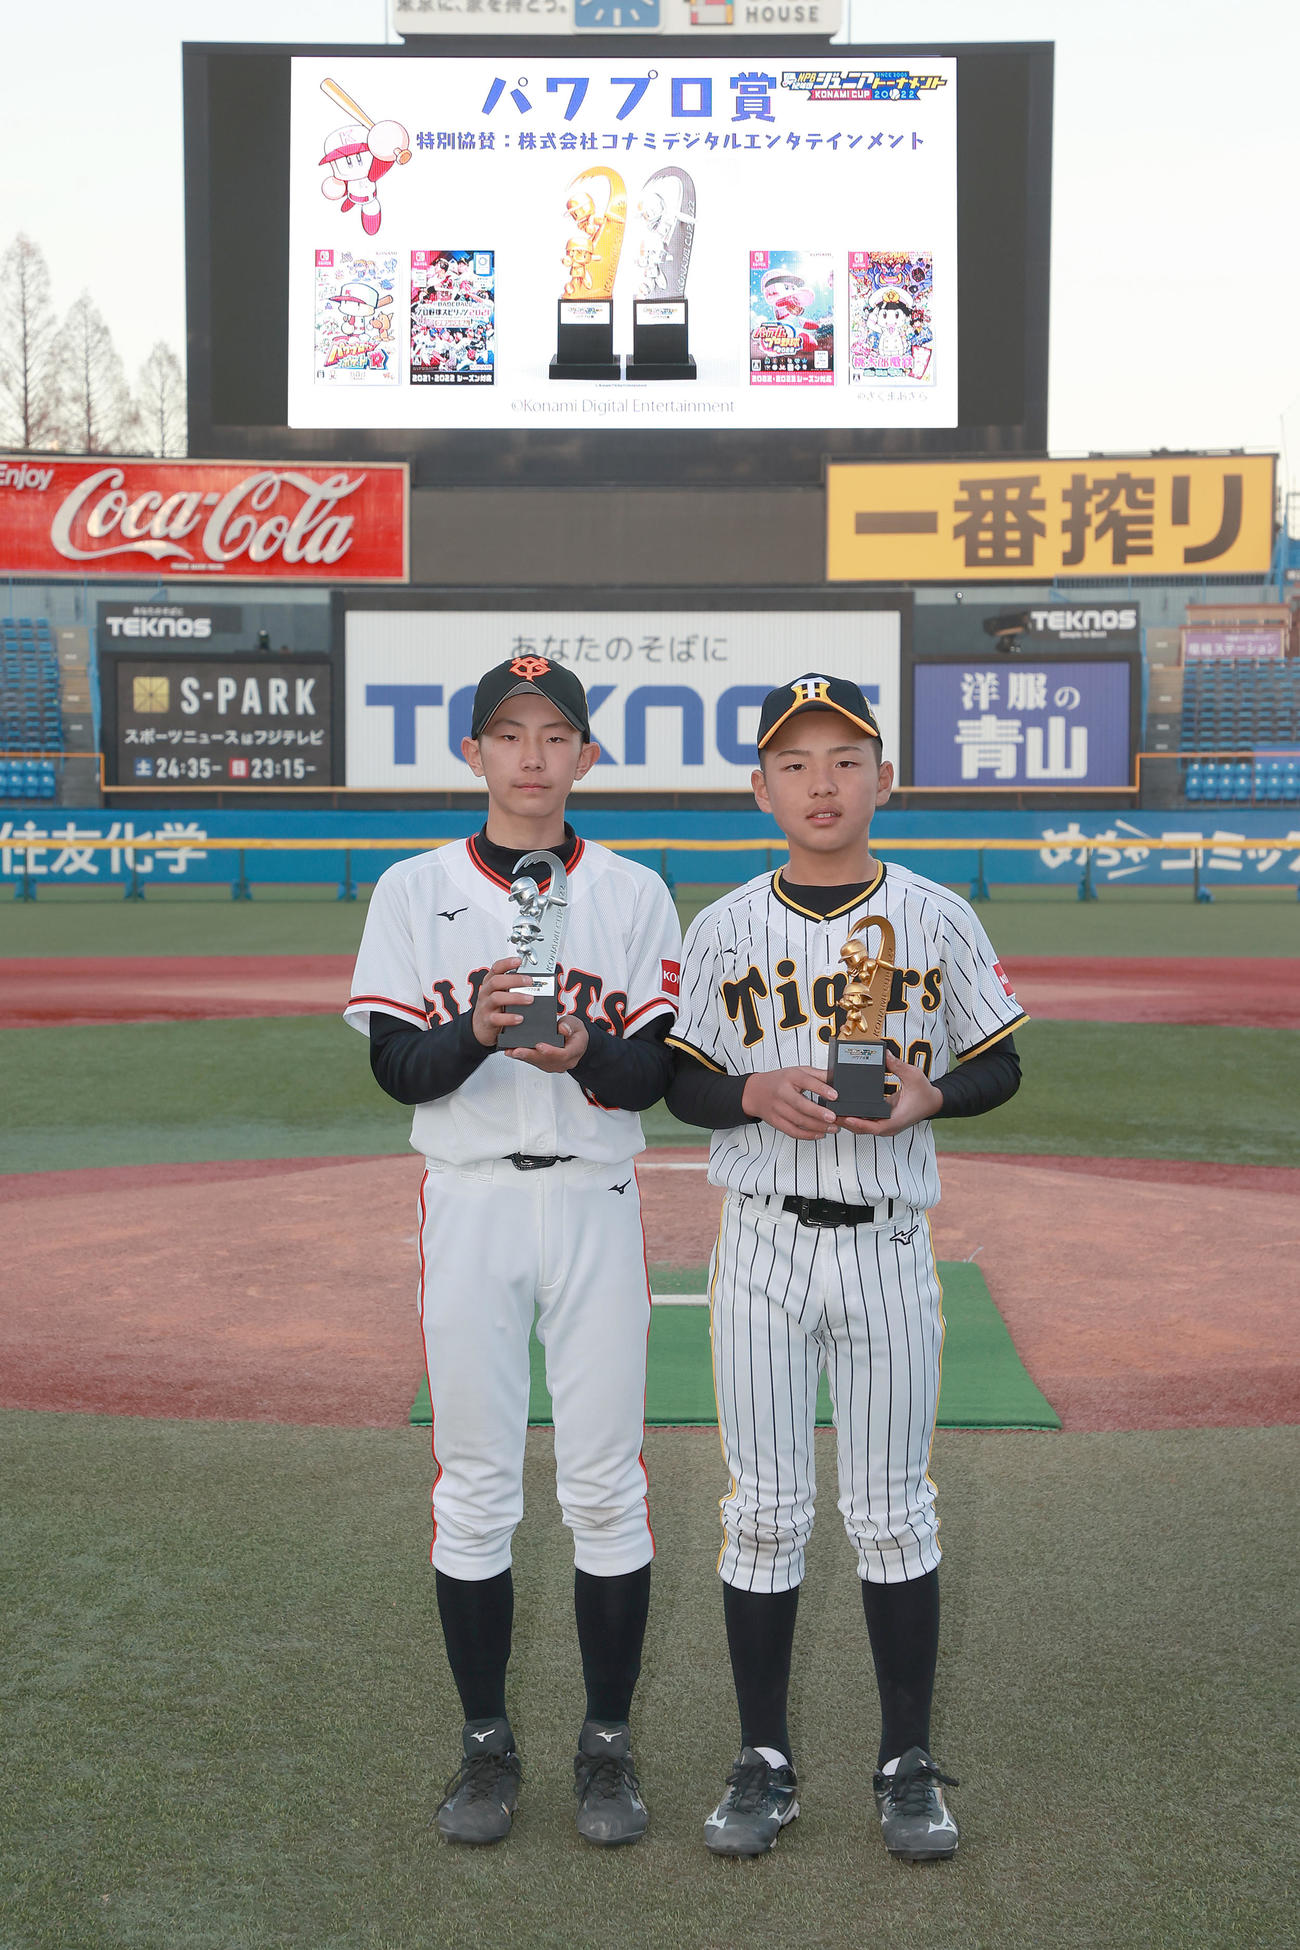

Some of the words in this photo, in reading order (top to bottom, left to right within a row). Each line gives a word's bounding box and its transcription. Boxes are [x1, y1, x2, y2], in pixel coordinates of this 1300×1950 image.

[746, 6, 819, 22] HOUSE
[481, 70, 777, 122] パワプロ賞
[815, 90, 850, 99] KONAMI
[852, 90, 870, 99] CUP
[416, 131, 924, 151] 特別協賛：株式会社コナミデジタルエンタテインメント
[511, 399, 577, 413] ©Konami
[582, 399, 628, 416] Digital
[633, 399, 735, 413] Entertainment
[0, 463, 54, 492] Enjoy
[50, 467, 367, 565] Coca-Cola
[855, 473, 1243, 567] 一番搾り
[106, 616, 212, 638] TEKNOS
[1031, 609, 1137, 631] TEKNOS
[511, 635, 728, 663] あなたのそばに
[180, 677, 316, 716] S-PARK
[961, 671, 1081, 711] 洋服の
[124, 728, 325, 746] スポーツニュースはフジテレビ
[954, 714, 1088, 780] 青山
[136, 761, 152, 776] 土
[0, 820, 208, 875] 住友化学
[722, 957, 944, 1048] Tigrs
